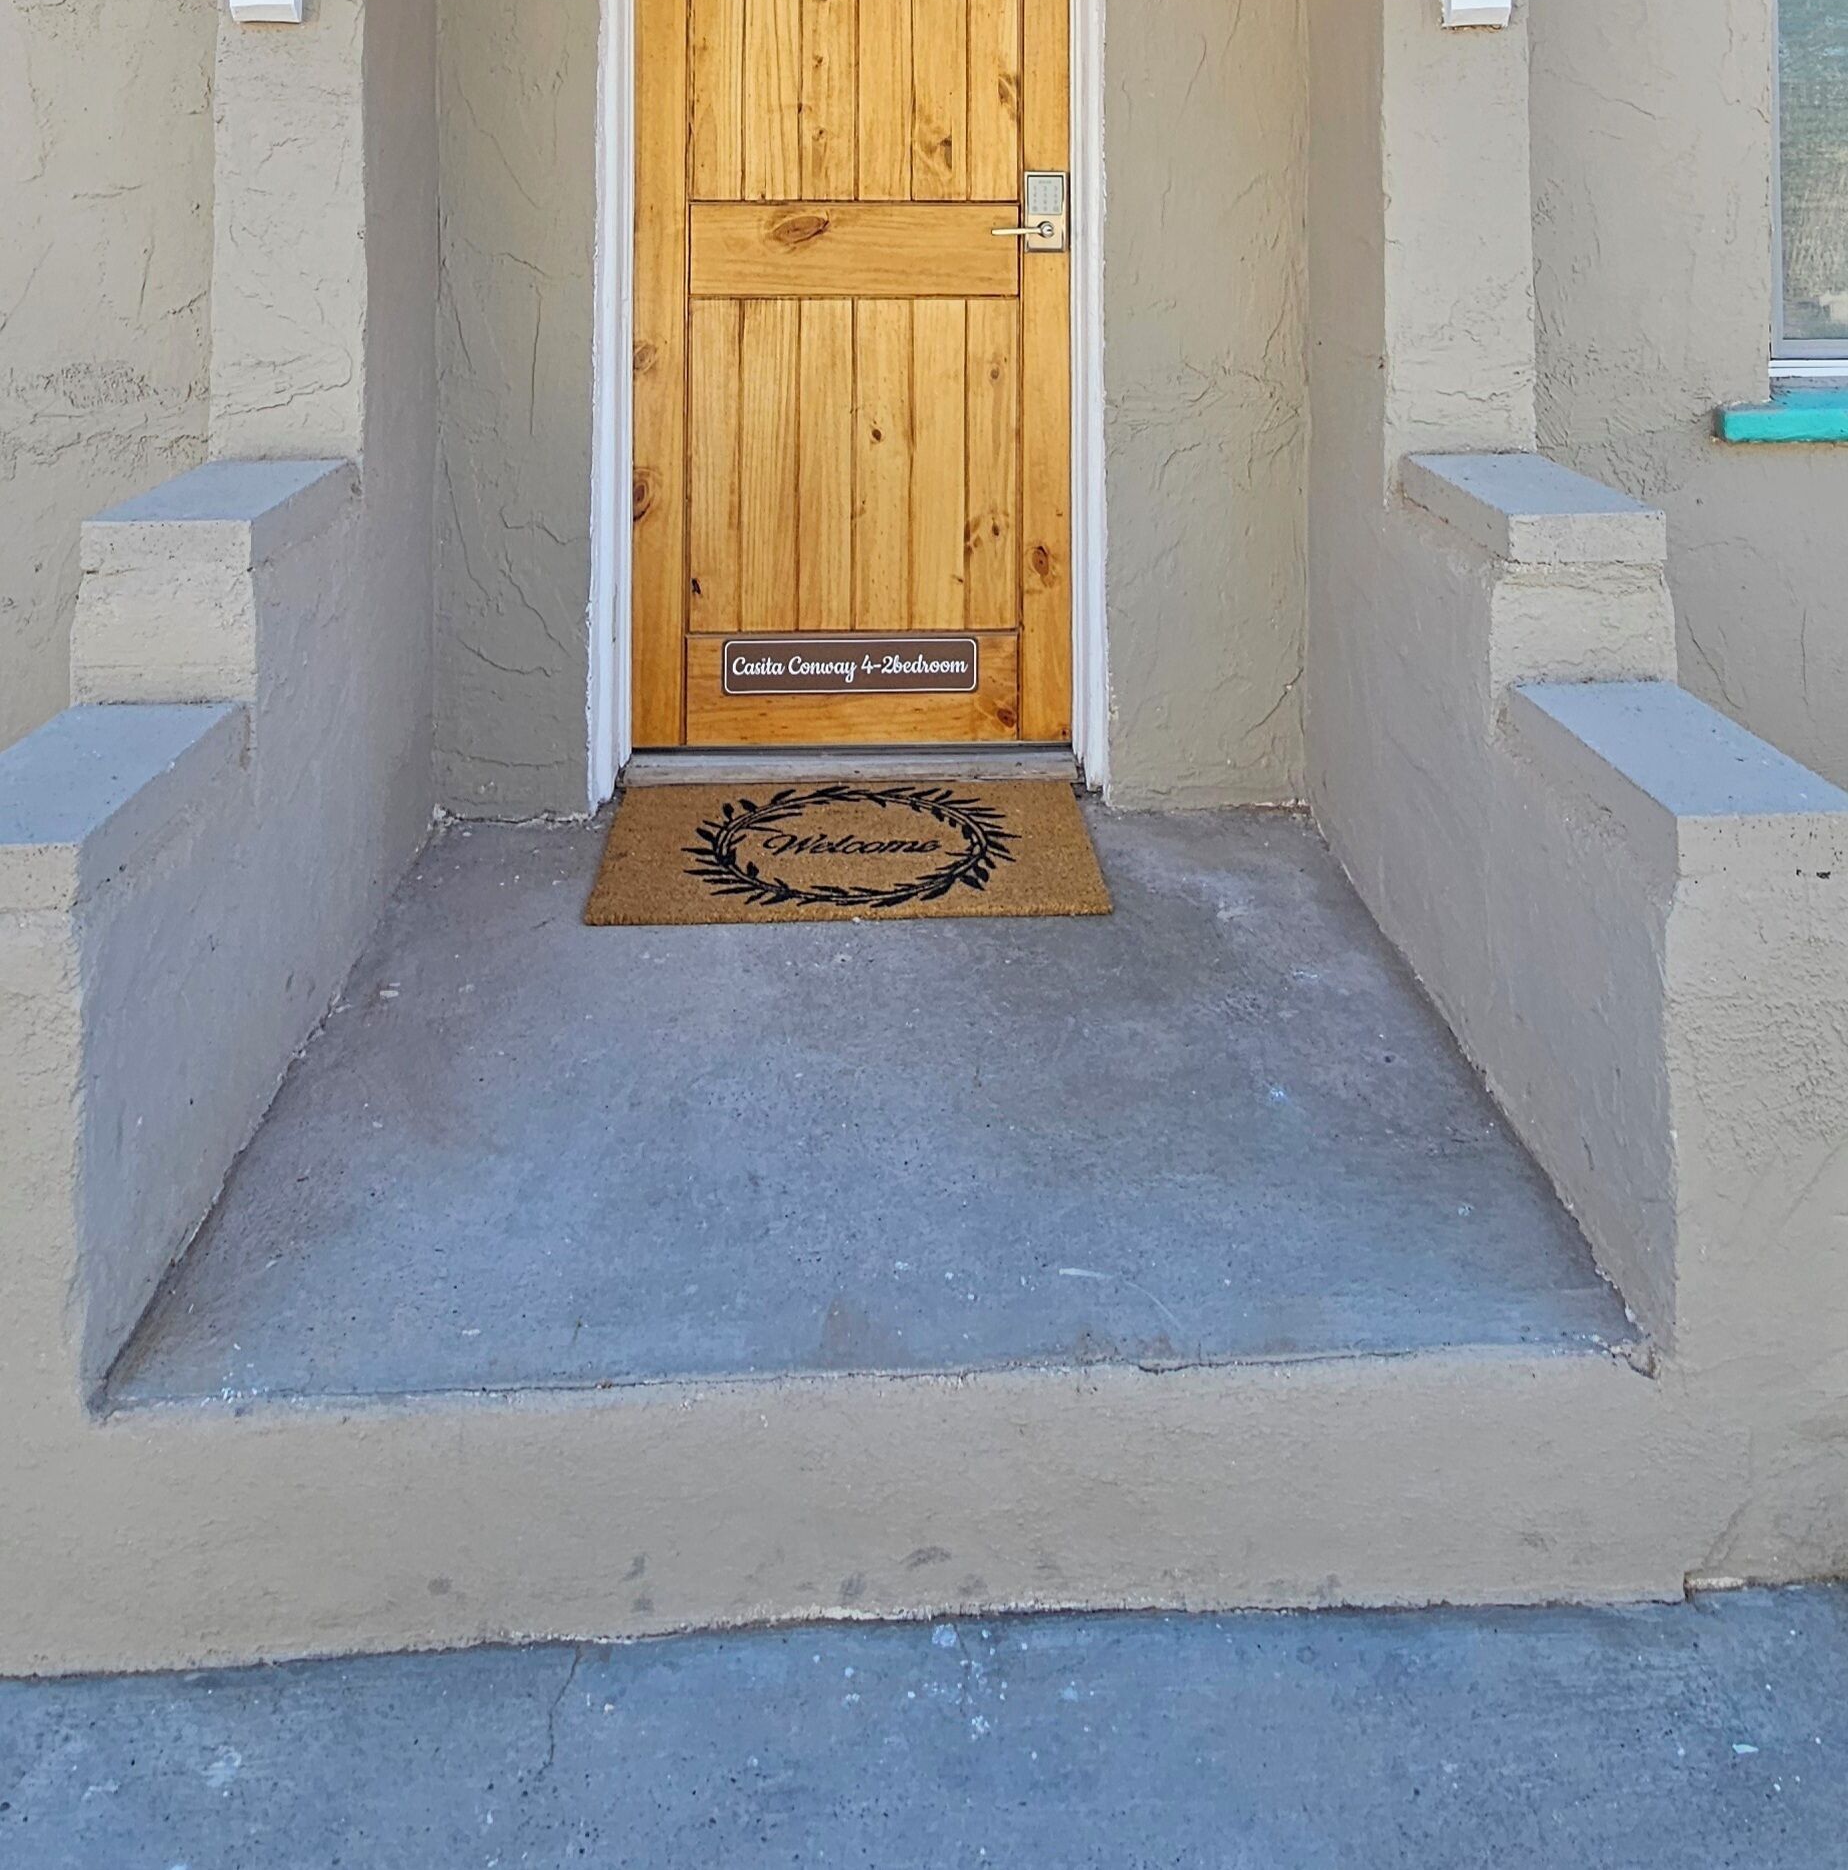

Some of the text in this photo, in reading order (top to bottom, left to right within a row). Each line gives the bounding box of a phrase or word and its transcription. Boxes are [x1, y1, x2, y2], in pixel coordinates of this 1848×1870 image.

[732, 654, 968, 683] Casita Conway 4-2bedroom
[762, 833, 942, 856] Welcome
